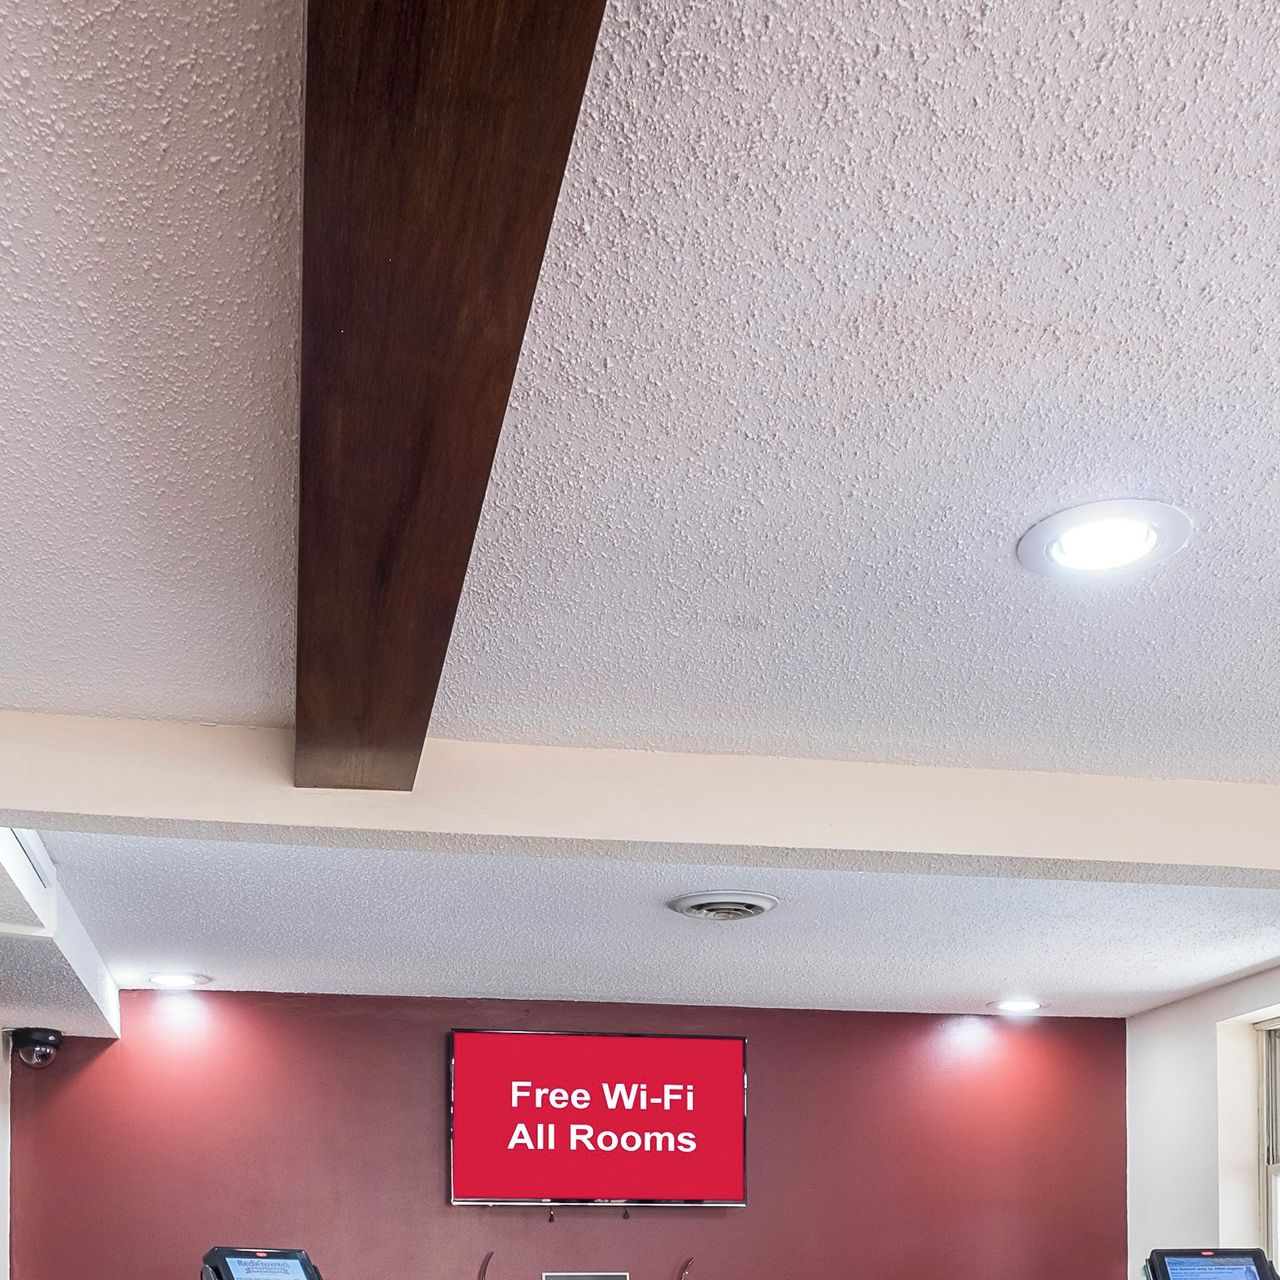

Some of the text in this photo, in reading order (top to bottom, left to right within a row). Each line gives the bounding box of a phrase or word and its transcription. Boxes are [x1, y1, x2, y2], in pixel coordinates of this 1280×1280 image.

[511, 1081, 694, 1111] Free Wi-Fi
[507, 1123, 697, 1153] All Rooms
